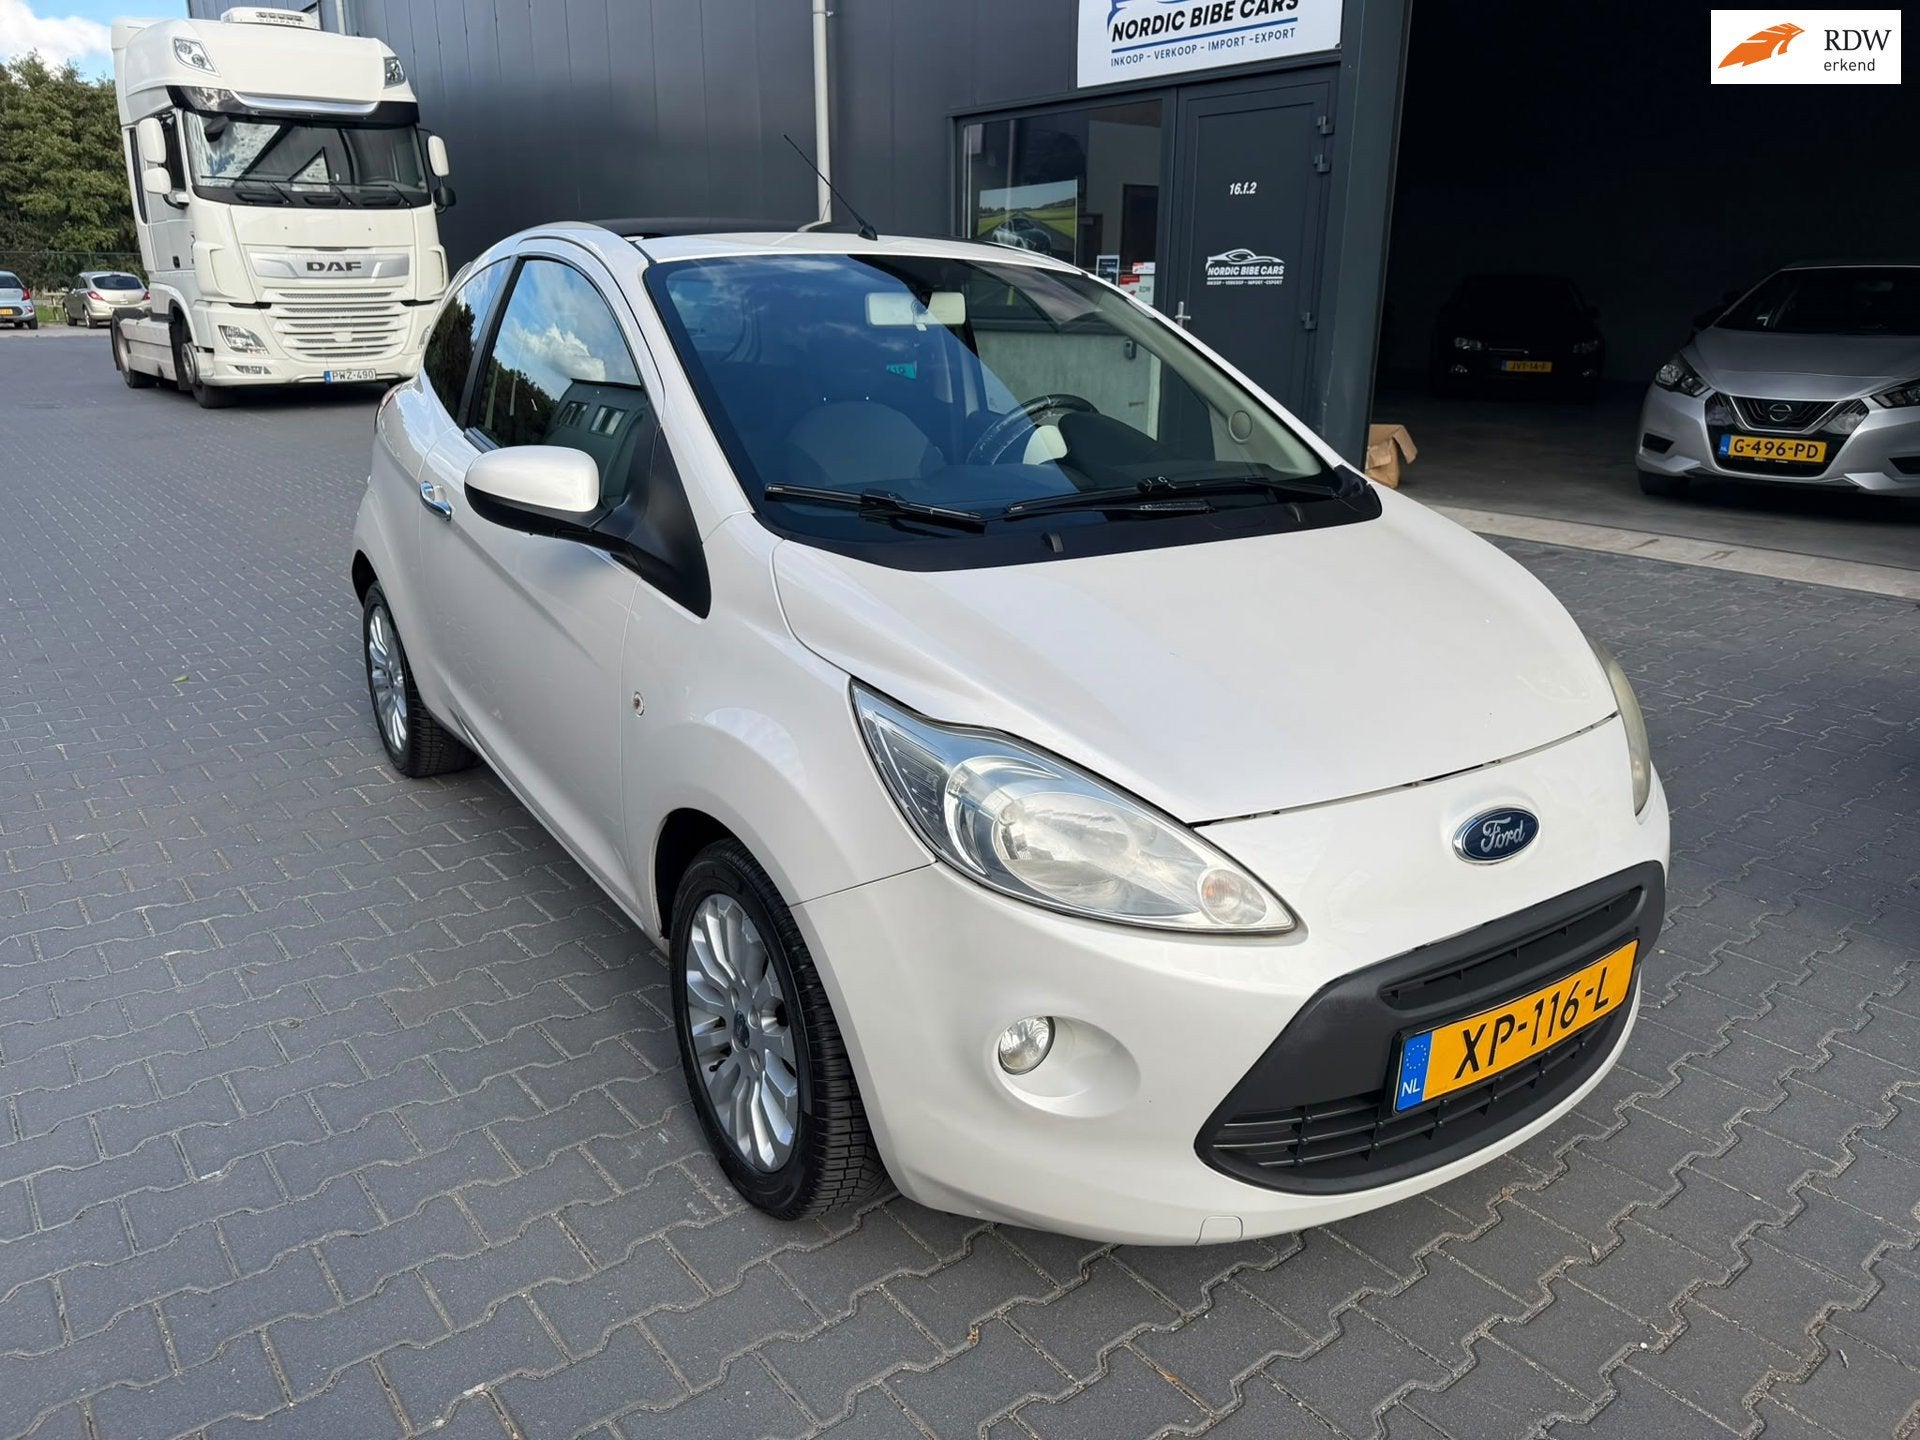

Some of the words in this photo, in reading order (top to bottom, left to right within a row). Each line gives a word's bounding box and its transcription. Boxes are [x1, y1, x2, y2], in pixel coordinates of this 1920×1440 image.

[1112, 9, 1185, 42] NORDIC
[1190, 1, 1235, 28] BIBE
[1240, 0, 1299, 19] CARS
[1111, 53, 1145, 67] INKOOP
[1154, 44, 1197, 60] VERKOOP
[1208, 36, 1246, 51] IMPORT
[306, 261, 362, 272] DAF
[1207, 266, 1240, 276] NORDIC
[1240, 266, 1260, 275] BIBE
[1260, 265, 1285, 275] CARS
[333, 370, 374, 380] PWZ-490
[1733, 439, 1819, 459] G-496-PD
[1480, 816, 1526, 853] Ford
[1454, 967, 1609, 1080] XP-116-L
[1401, 1078, 1420, 1097] NL
